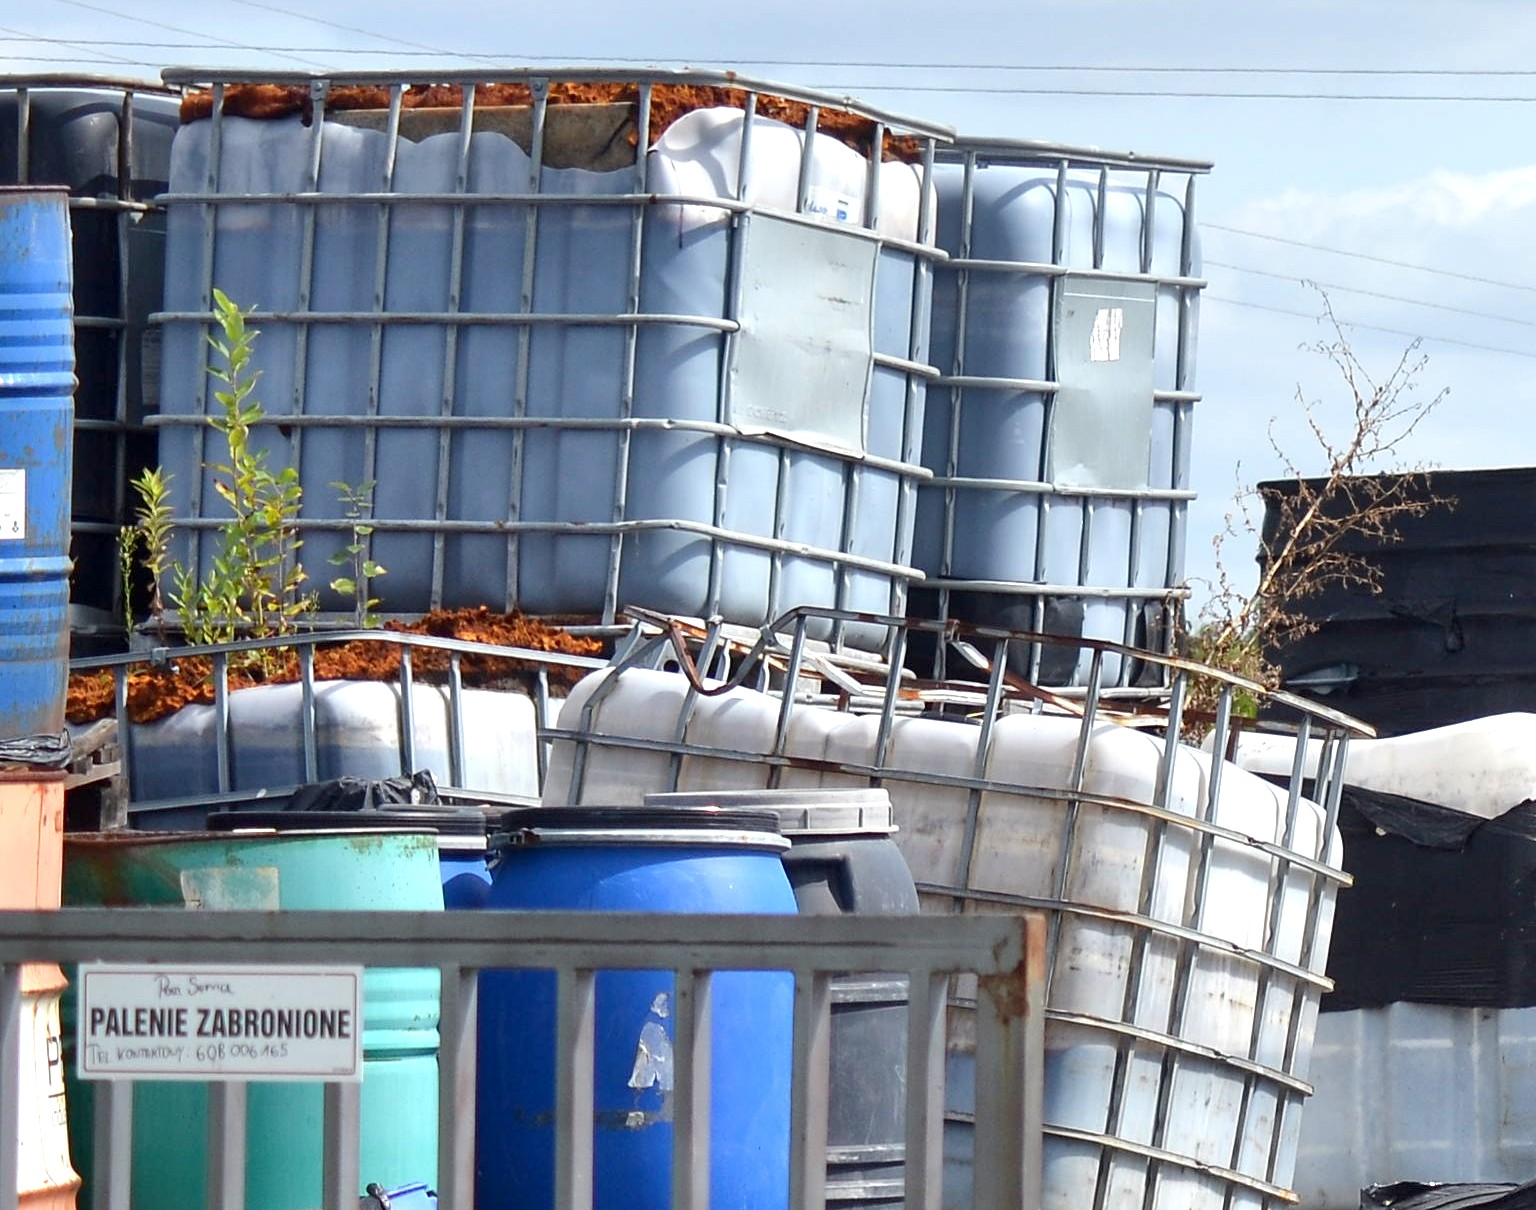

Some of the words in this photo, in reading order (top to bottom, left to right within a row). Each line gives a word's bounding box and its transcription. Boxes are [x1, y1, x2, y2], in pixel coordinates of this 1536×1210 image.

[91, 1007, 188, 1037] PALENIE
[197, 1009, 350, 1039] ZABRONIONE
[230, 1043, 257, 1059] 006
[262, 1043, 288, 1058] 165
